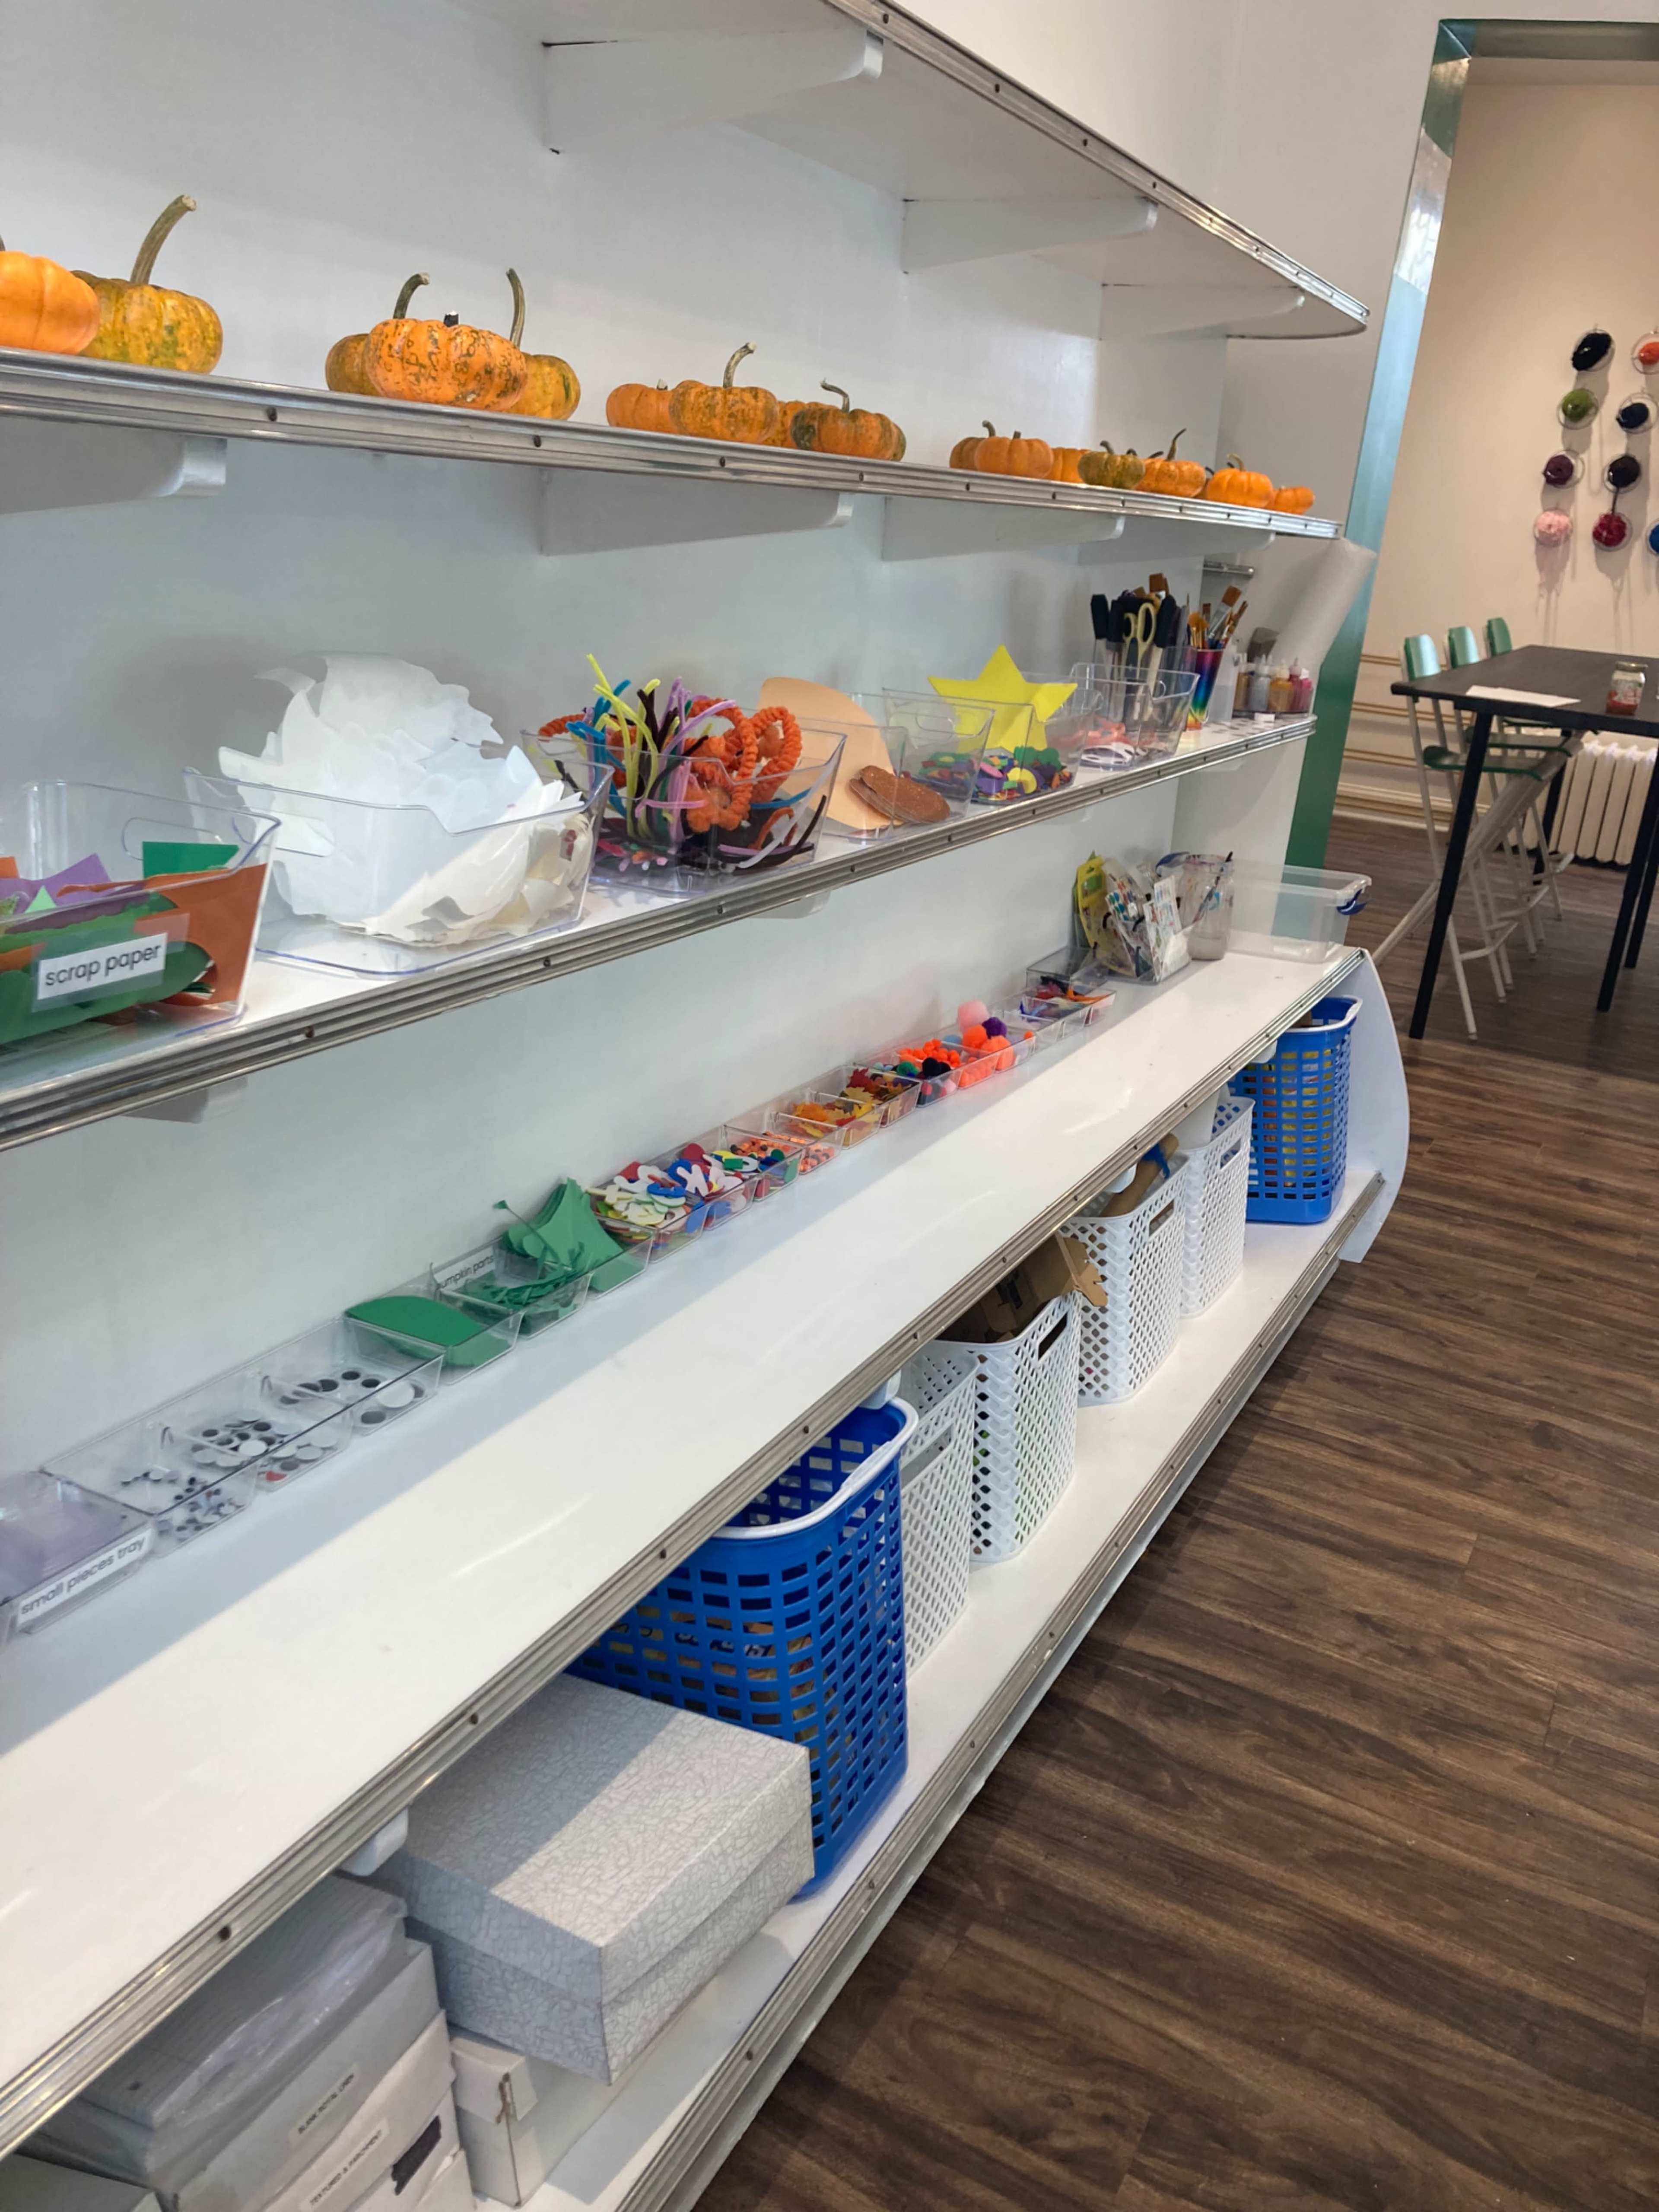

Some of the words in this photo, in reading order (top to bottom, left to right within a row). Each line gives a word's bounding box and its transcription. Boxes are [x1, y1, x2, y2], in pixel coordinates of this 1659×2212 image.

[45, 960, 101, 986] scrap
[105, 945, 161, 977] paper
[439, 1267, 473, 1289] umpkin
[21, 1582, 64, 1615] small
[66, 1554, 115, 1592] pieces
[117, 1536, 146, 1559] tray
